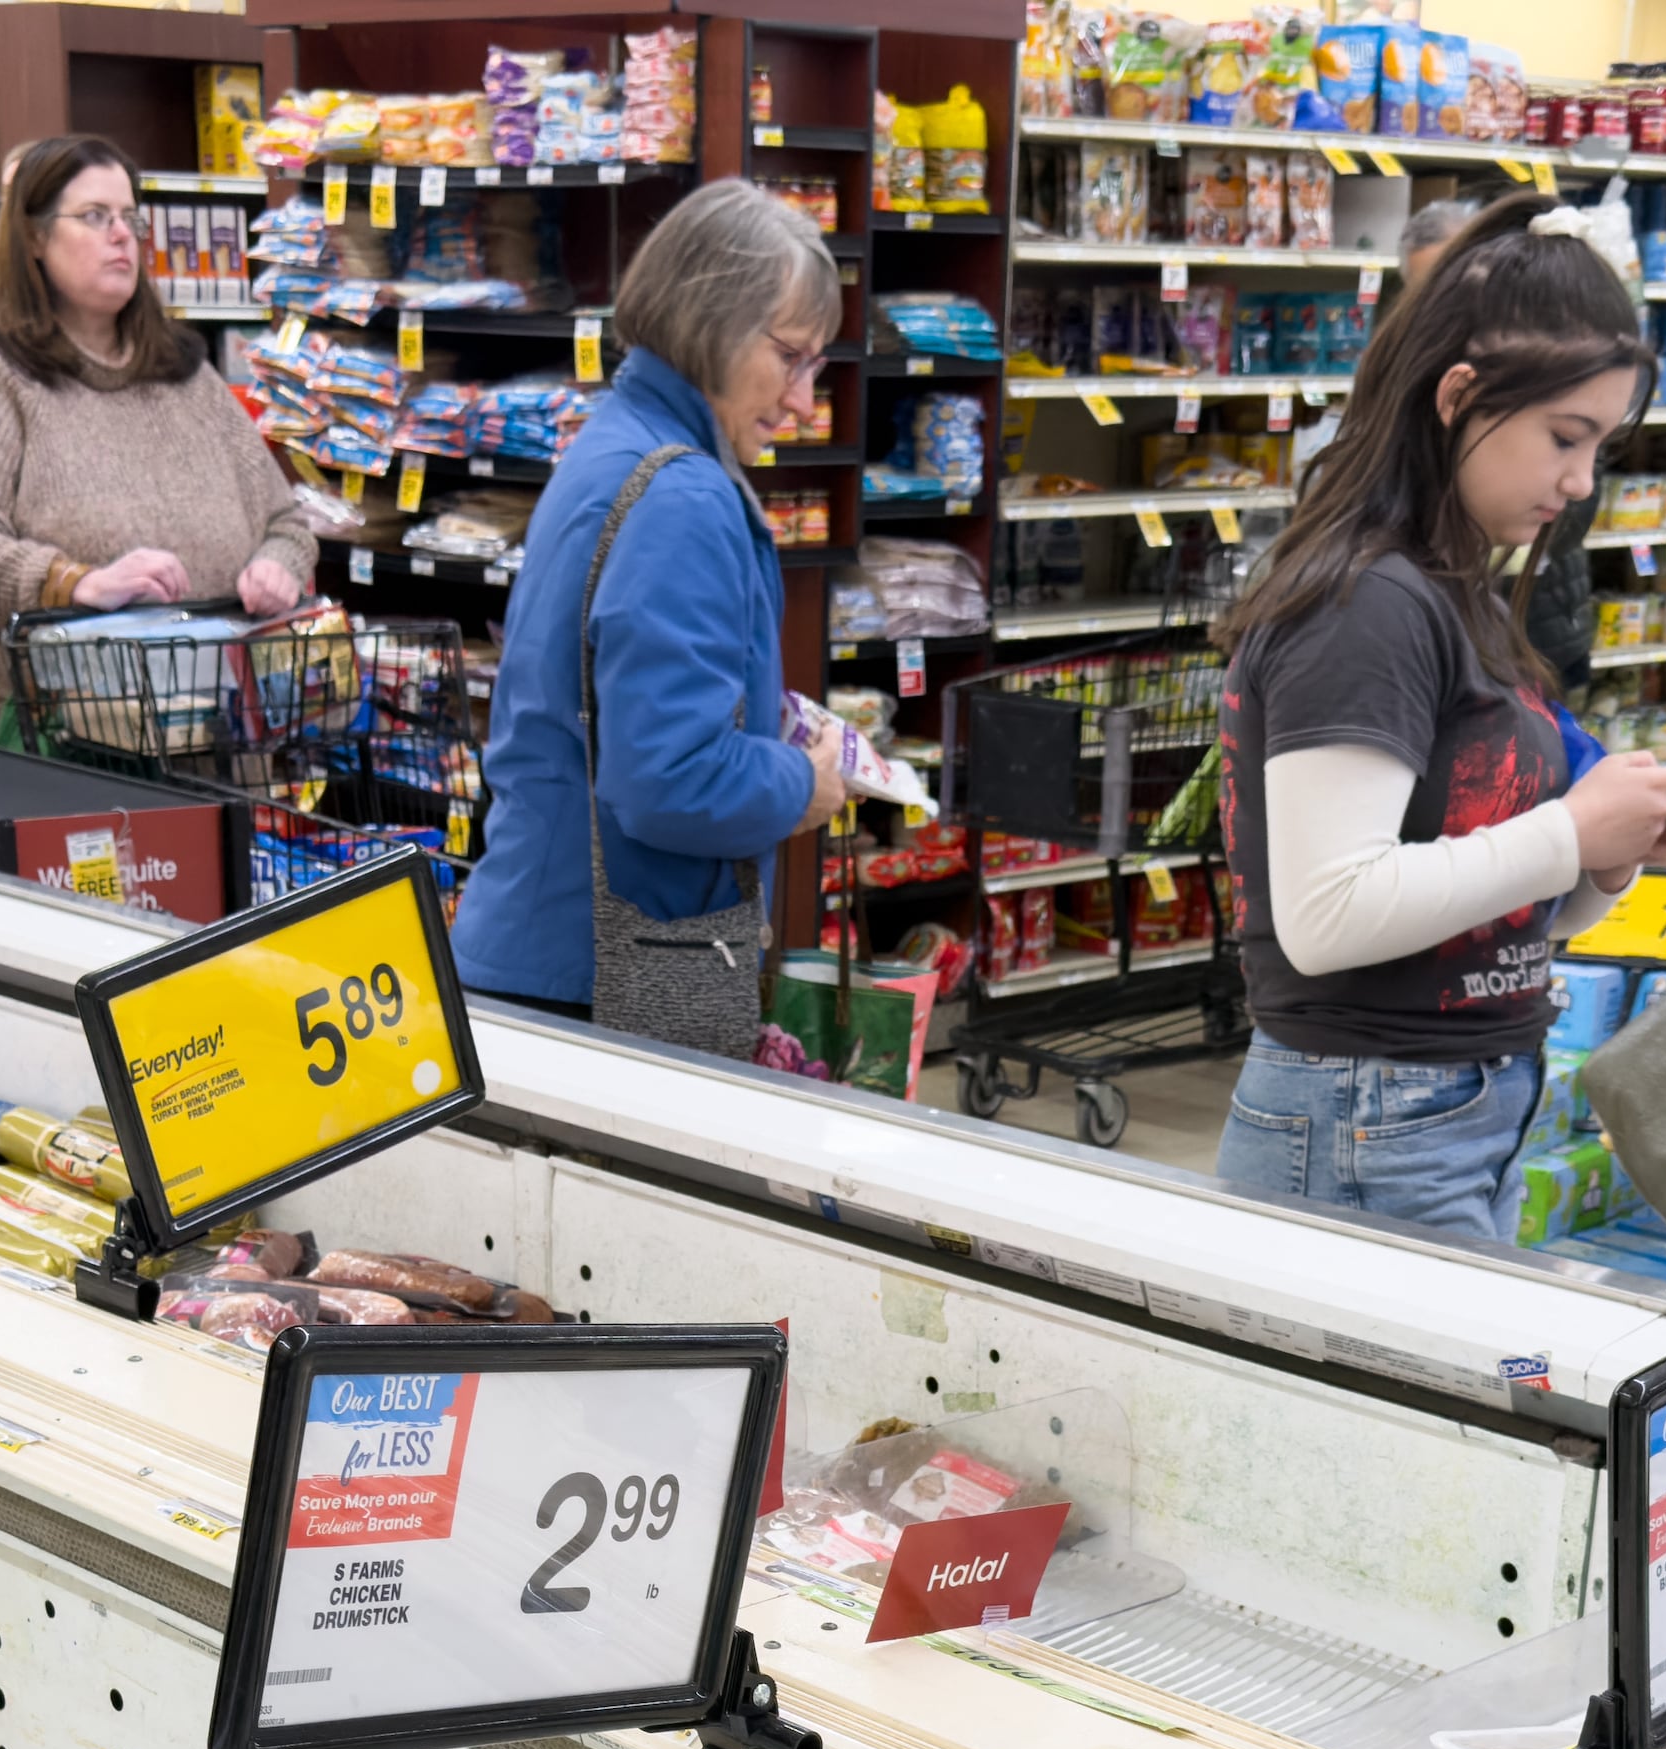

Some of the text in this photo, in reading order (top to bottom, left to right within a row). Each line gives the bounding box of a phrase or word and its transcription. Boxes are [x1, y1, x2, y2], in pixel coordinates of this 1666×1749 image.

[76, 877, 118, 897] FREE
[129, 1024, 225, 1085] Everyday!
[150, 1068, 240, 1112] SHADY BROOK FARMS
[151, 1078, 246, 1125] TURKEY WING PORTION
[187, 1102, 215, 1121] FRESH
[331, 1375, 441, 1416] Our BEST
[339, 1430, 436, 1487] for LESS
[298, 1491, 437, 1513] Save More on our
[305, 1514, 423, 1539] Exclusive Brands
[333, 1559, 405, 1582] S FARMS
[926, 1552, 1010, 1593] Halal
[329, 1583, 402, 1606] CHICKEN
[646, 1583, 660, 1601] lb
[312, 1605, 410, 1631] DRUMSTICK
